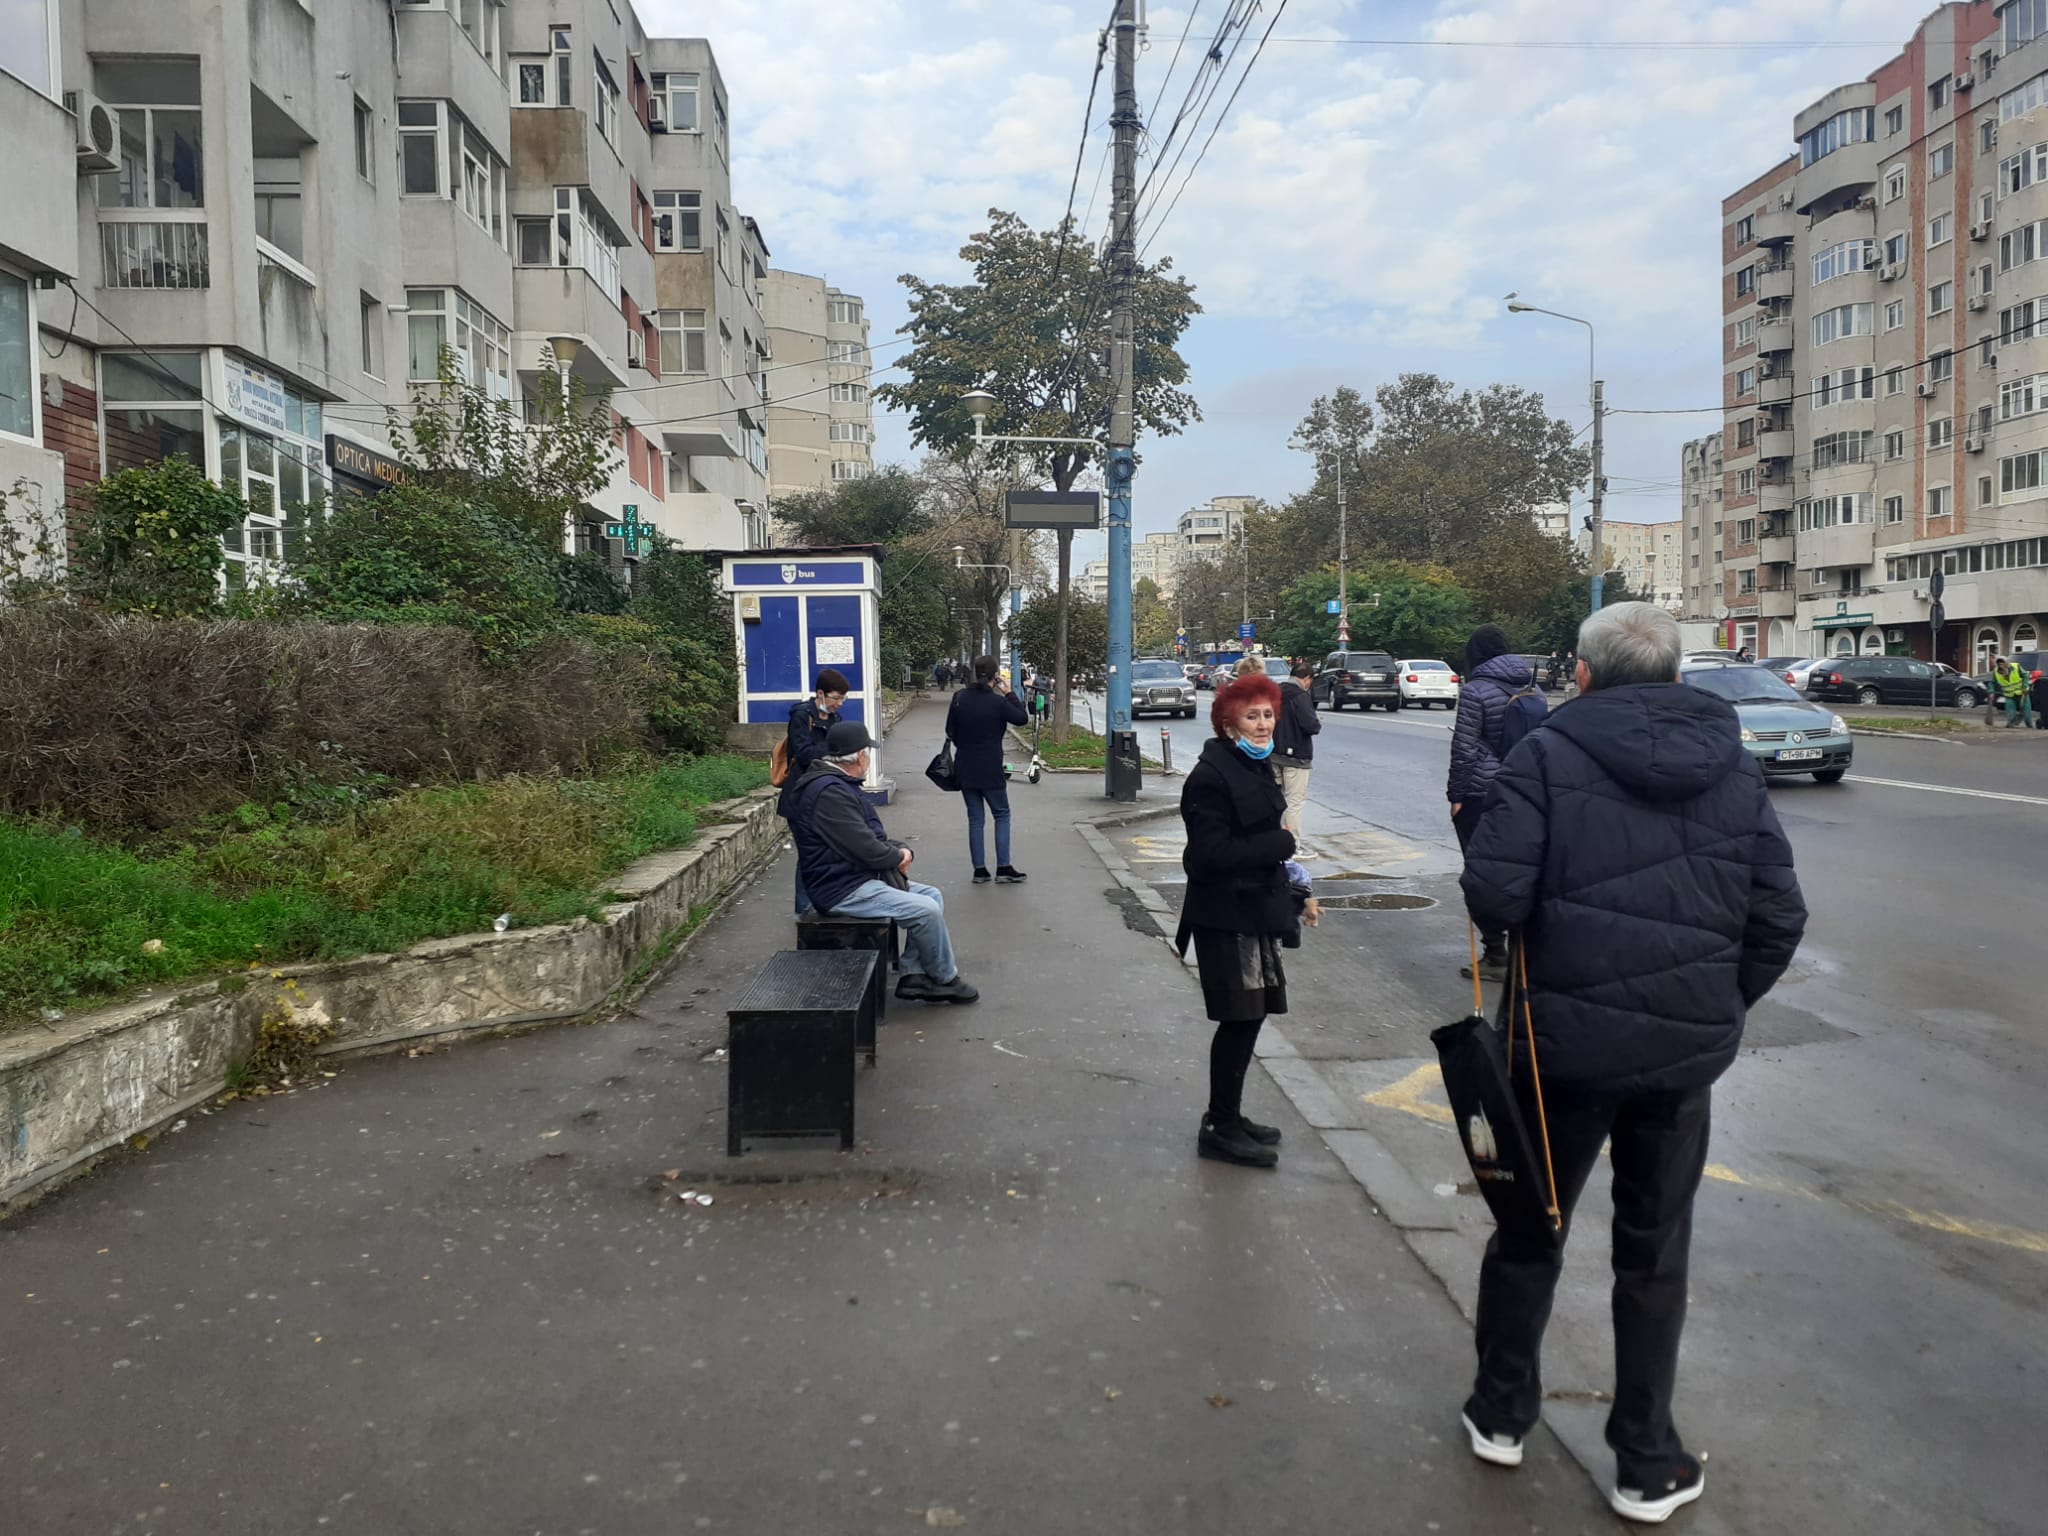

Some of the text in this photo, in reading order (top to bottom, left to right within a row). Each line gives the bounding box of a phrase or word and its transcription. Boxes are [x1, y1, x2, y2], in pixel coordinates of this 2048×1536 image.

[336, 443, 371, 475] OPTICA
[783, 570, 815, 578] CT bus
[1781, 751, 1792, 760] CT
